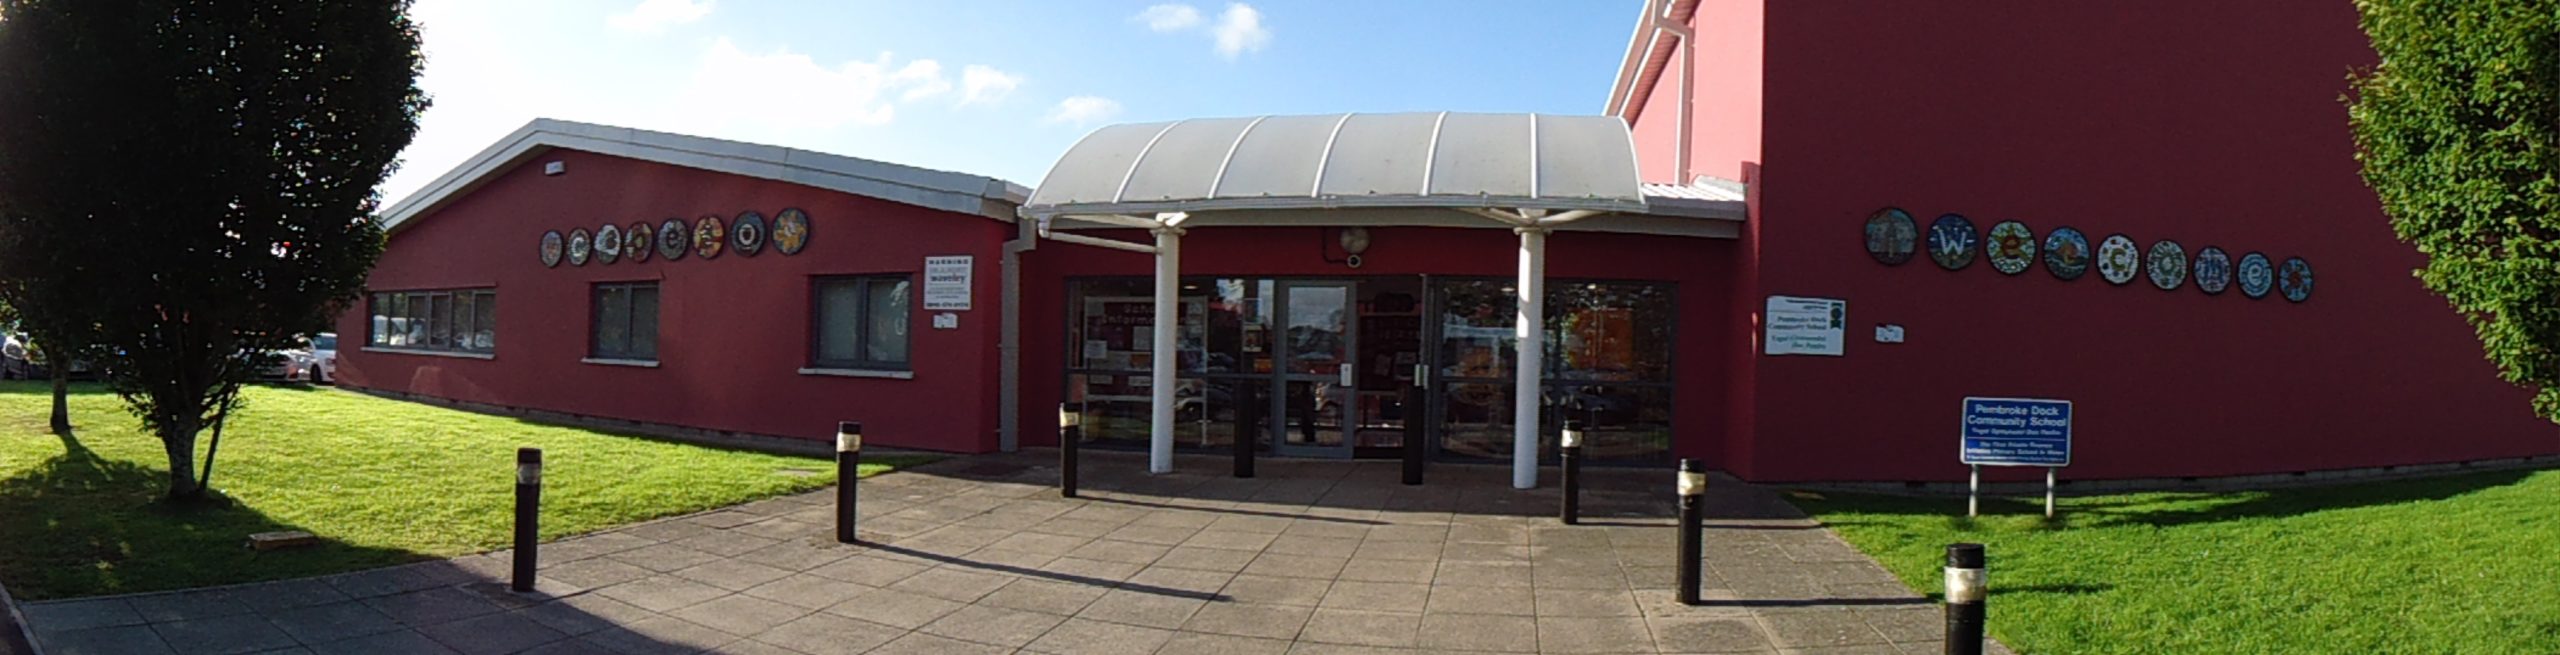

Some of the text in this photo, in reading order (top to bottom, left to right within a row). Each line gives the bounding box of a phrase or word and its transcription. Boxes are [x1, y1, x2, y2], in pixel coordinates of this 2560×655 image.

[1975, 404, 2059, 415] Pembroke Dock
[1967, 415, 2067, 428] Community School
